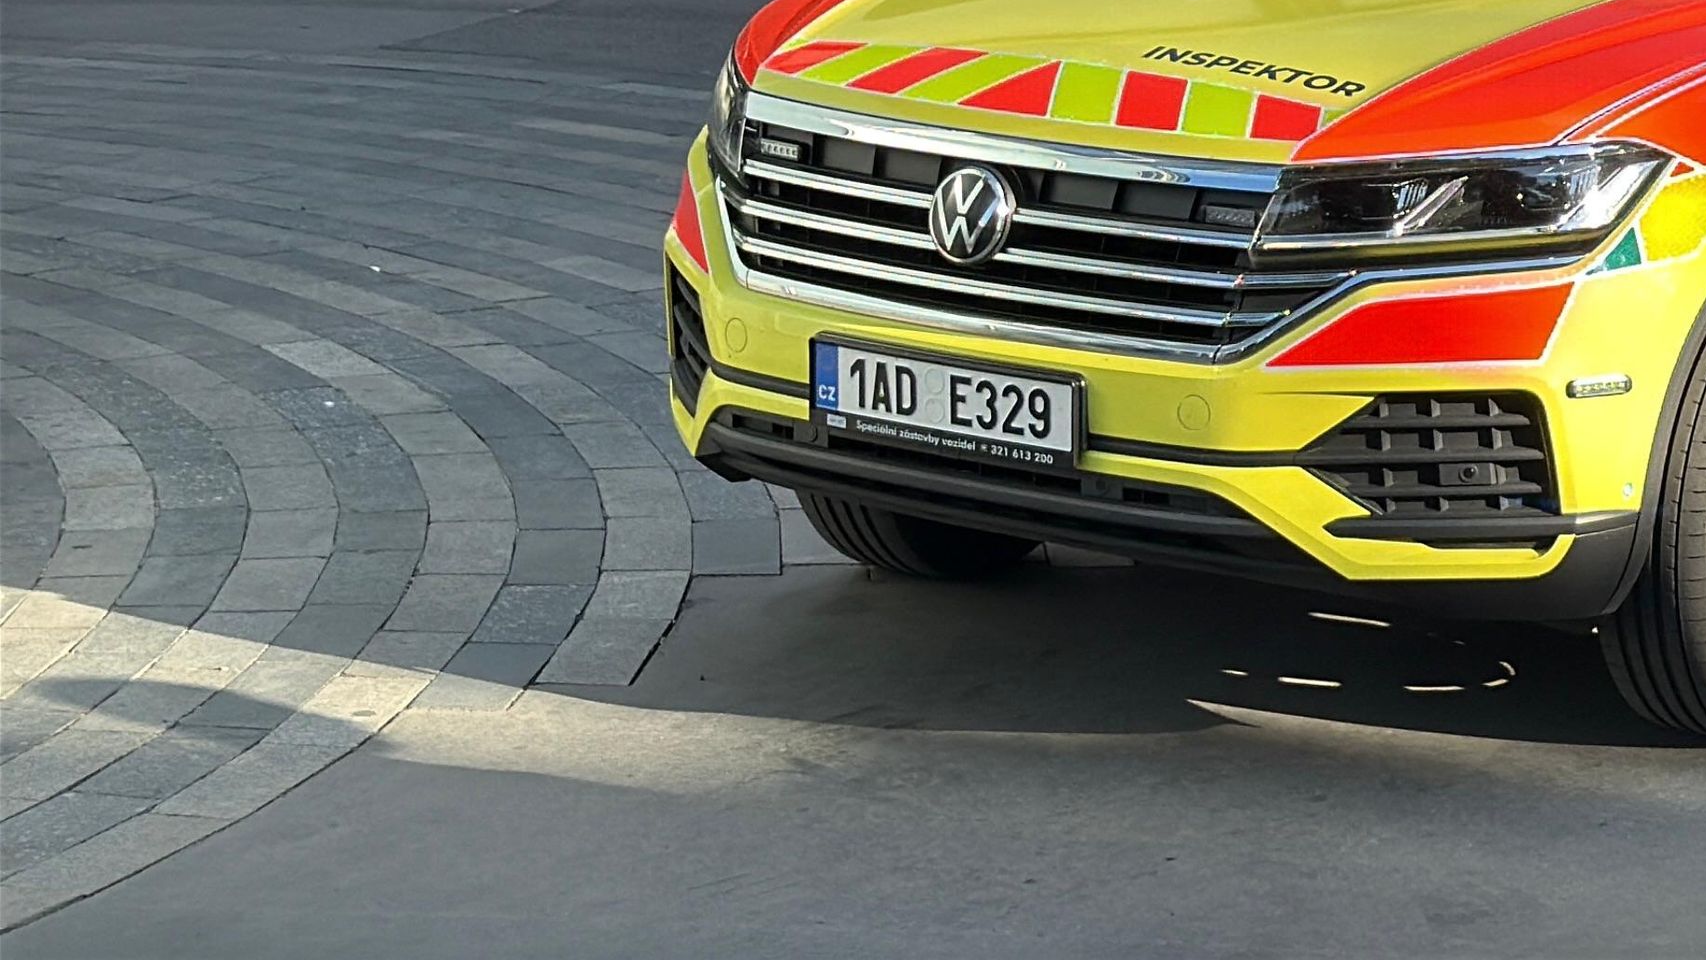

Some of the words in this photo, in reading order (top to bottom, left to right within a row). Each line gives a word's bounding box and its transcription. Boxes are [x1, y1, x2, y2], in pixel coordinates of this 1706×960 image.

[1141, 46, 1366, 97] INSPEKTOR
[818, 383, 836, 402] CZ
[849, 358, 917, 416] 1AD
[950, 374, 1052, 439] E329
[941, 438, 976, 451] vozidel
[991, 444, 1009, 457] 321
[1012, 448, 1032, 461] 613
[1034, 452, 1054, 465] 200
